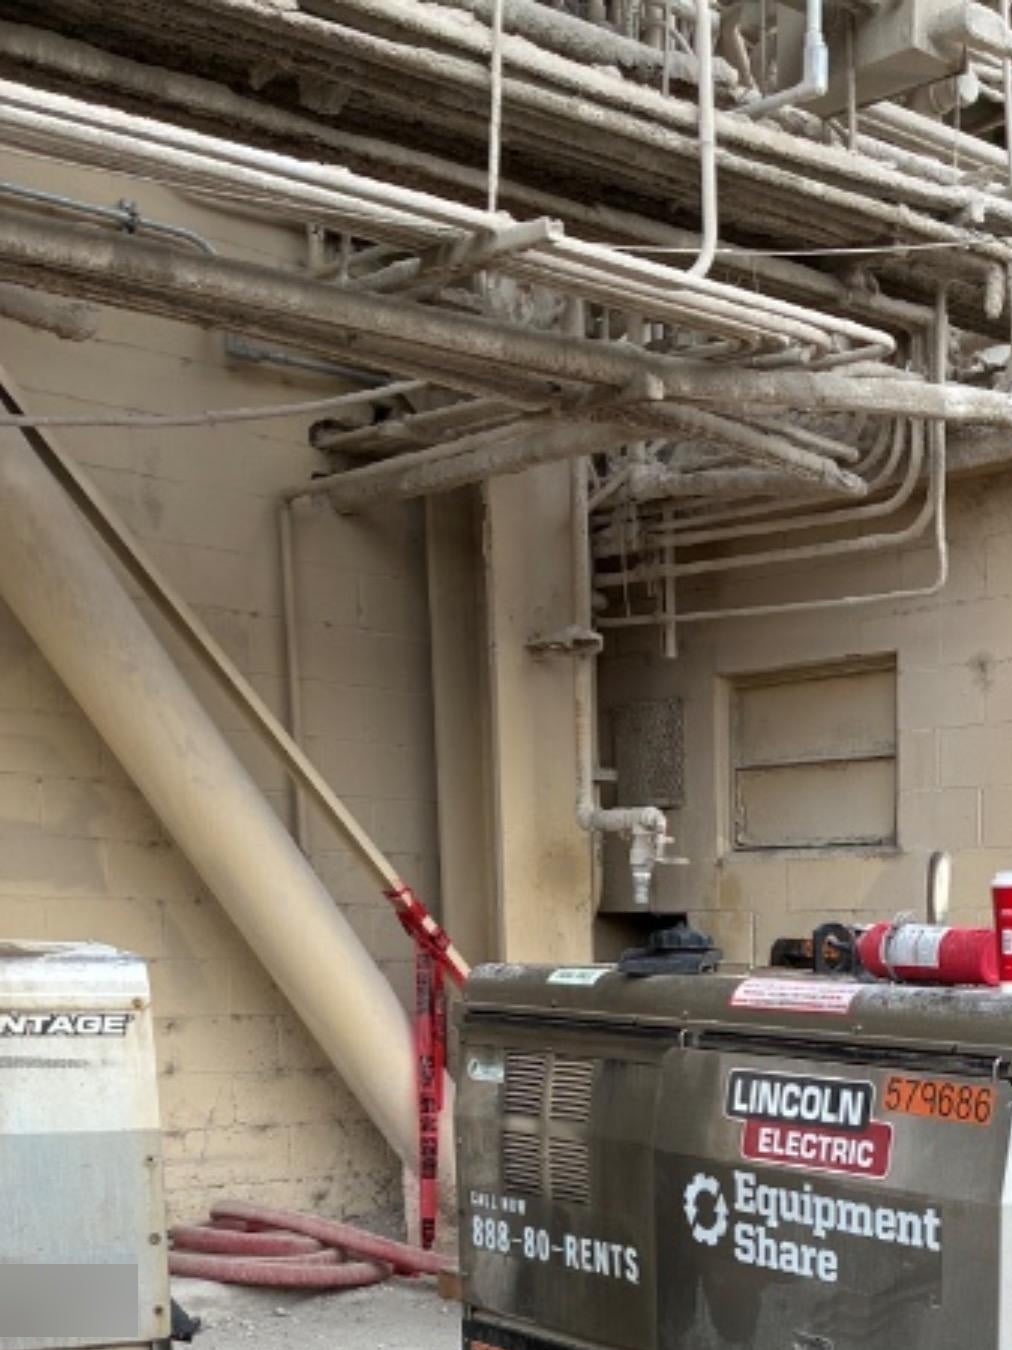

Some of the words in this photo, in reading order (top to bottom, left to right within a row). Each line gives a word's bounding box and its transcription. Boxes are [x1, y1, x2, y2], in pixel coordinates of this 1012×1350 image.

[732, 1078, 864, 1126] LINCOLN
[885, 1076, 991, 1122] 579686
[757, 1127, 874, 1167] ELECTRIC
[470, 1191, 498, 1211] CALL
[733, 1170, 942, 1251] Equipment
[472, 1214, 640, 1285] 888-80-RENTS
[734, 1222, 838, 1282] Share
